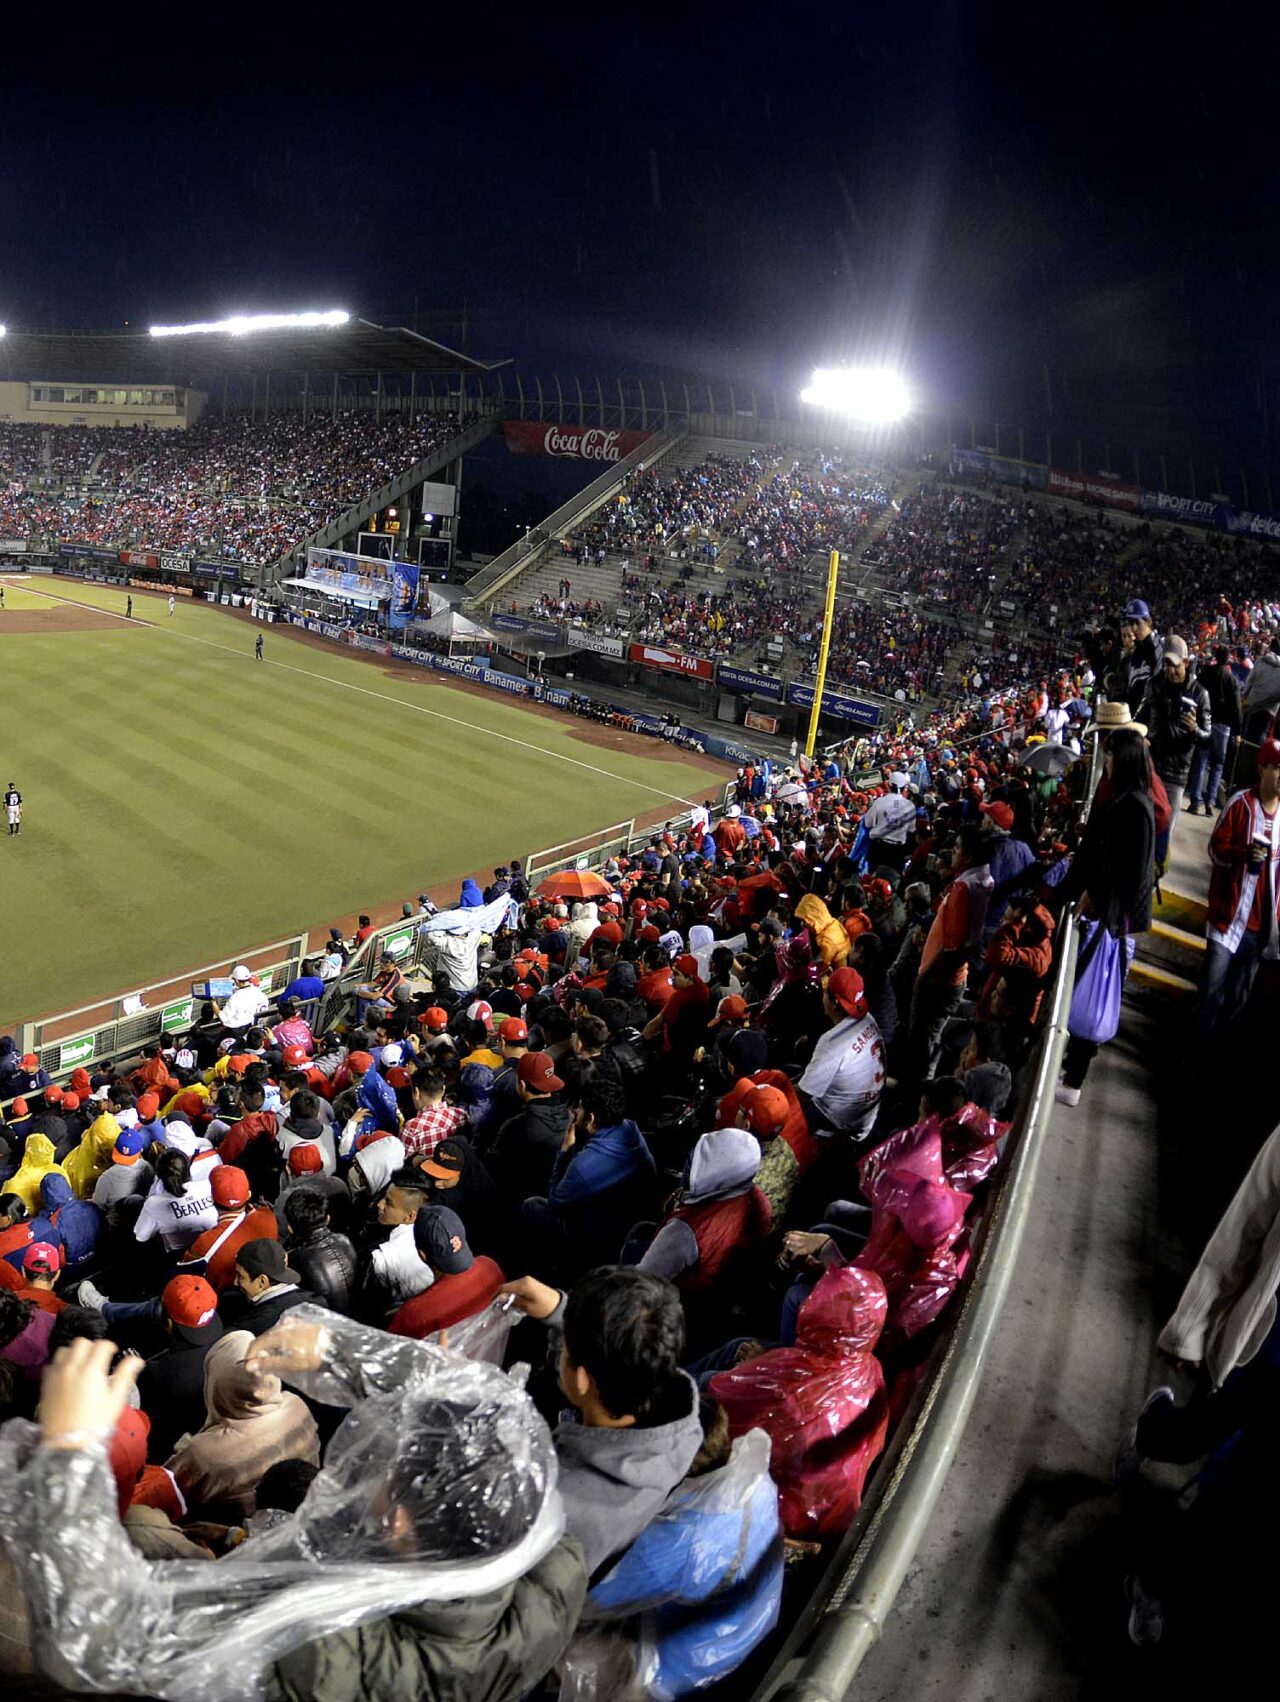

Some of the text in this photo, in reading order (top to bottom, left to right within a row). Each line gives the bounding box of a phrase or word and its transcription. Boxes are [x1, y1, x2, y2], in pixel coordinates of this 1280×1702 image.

[544, 426, 620, 461] Coca-Cola
[1158, 491, 1218, 515] SPORT CITY
[162, 558, 188, 570] OCESA
[398, 646, 418, 659] SPORT
[418, 650, 434, 663] CITY
[442, 657, 463, 671] SPORT
[464, 663, 481, 676] CITY
[484, 670, 526, 692] Banamex
